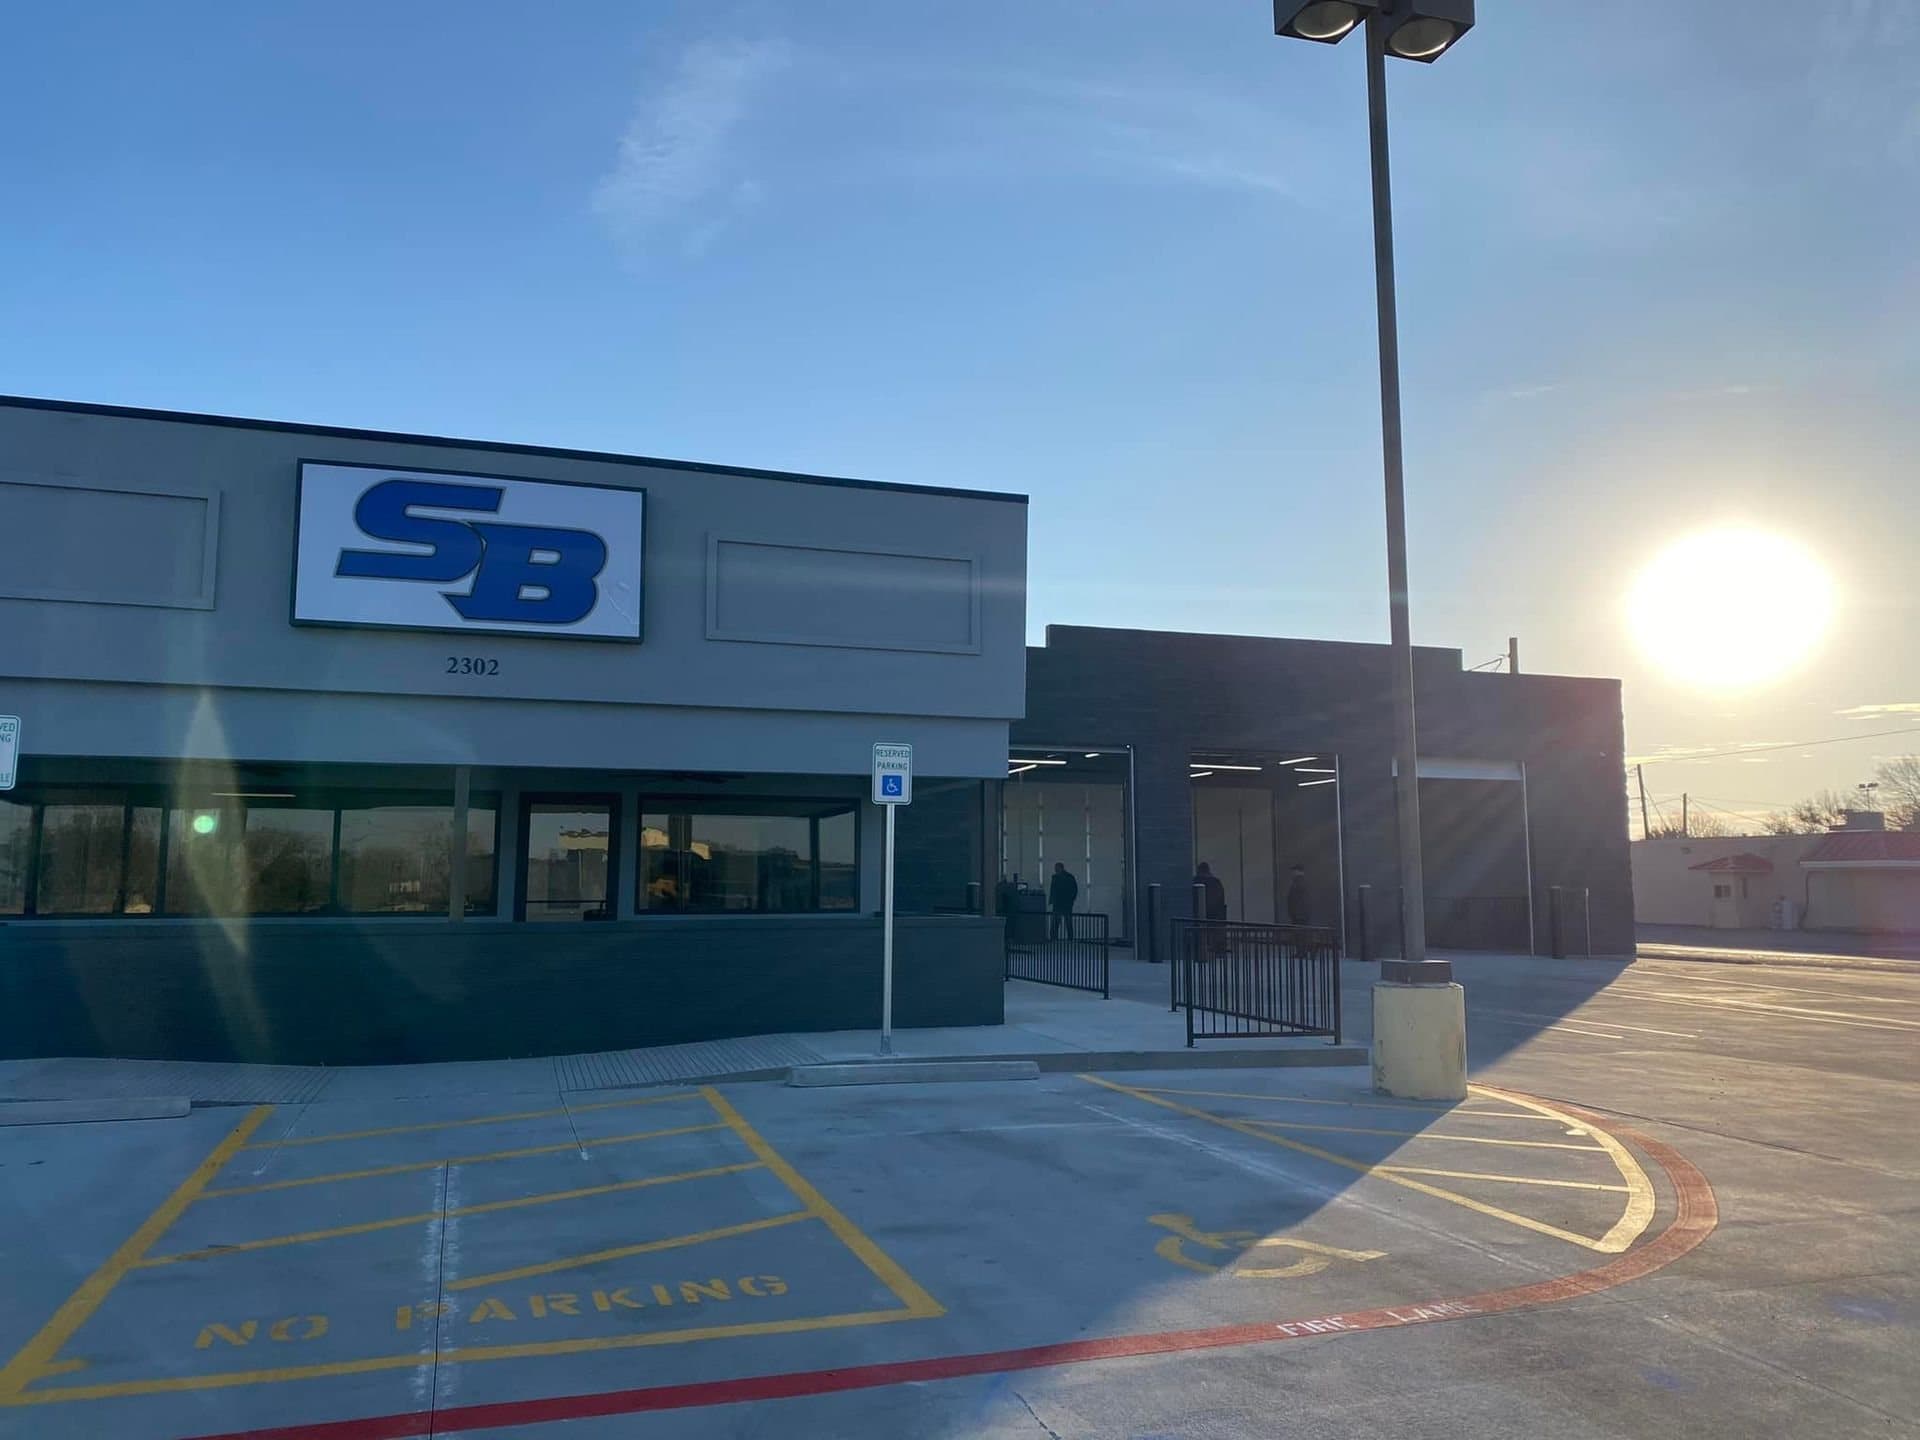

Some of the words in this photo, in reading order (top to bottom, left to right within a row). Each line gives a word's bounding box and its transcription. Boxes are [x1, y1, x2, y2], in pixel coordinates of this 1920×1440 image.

[446, 656, 500, 676] 2302
[876, 749, 909, 758] RESERVED
[876, 761, 908, 769] PARKING
[193, 1314, 329, 1349] NO
[395, 1275, 789, 1331] PARKING
[1276, 1316, 1360, 1337] FIRE
[1385, 1301, 1482, 1322] LANE
